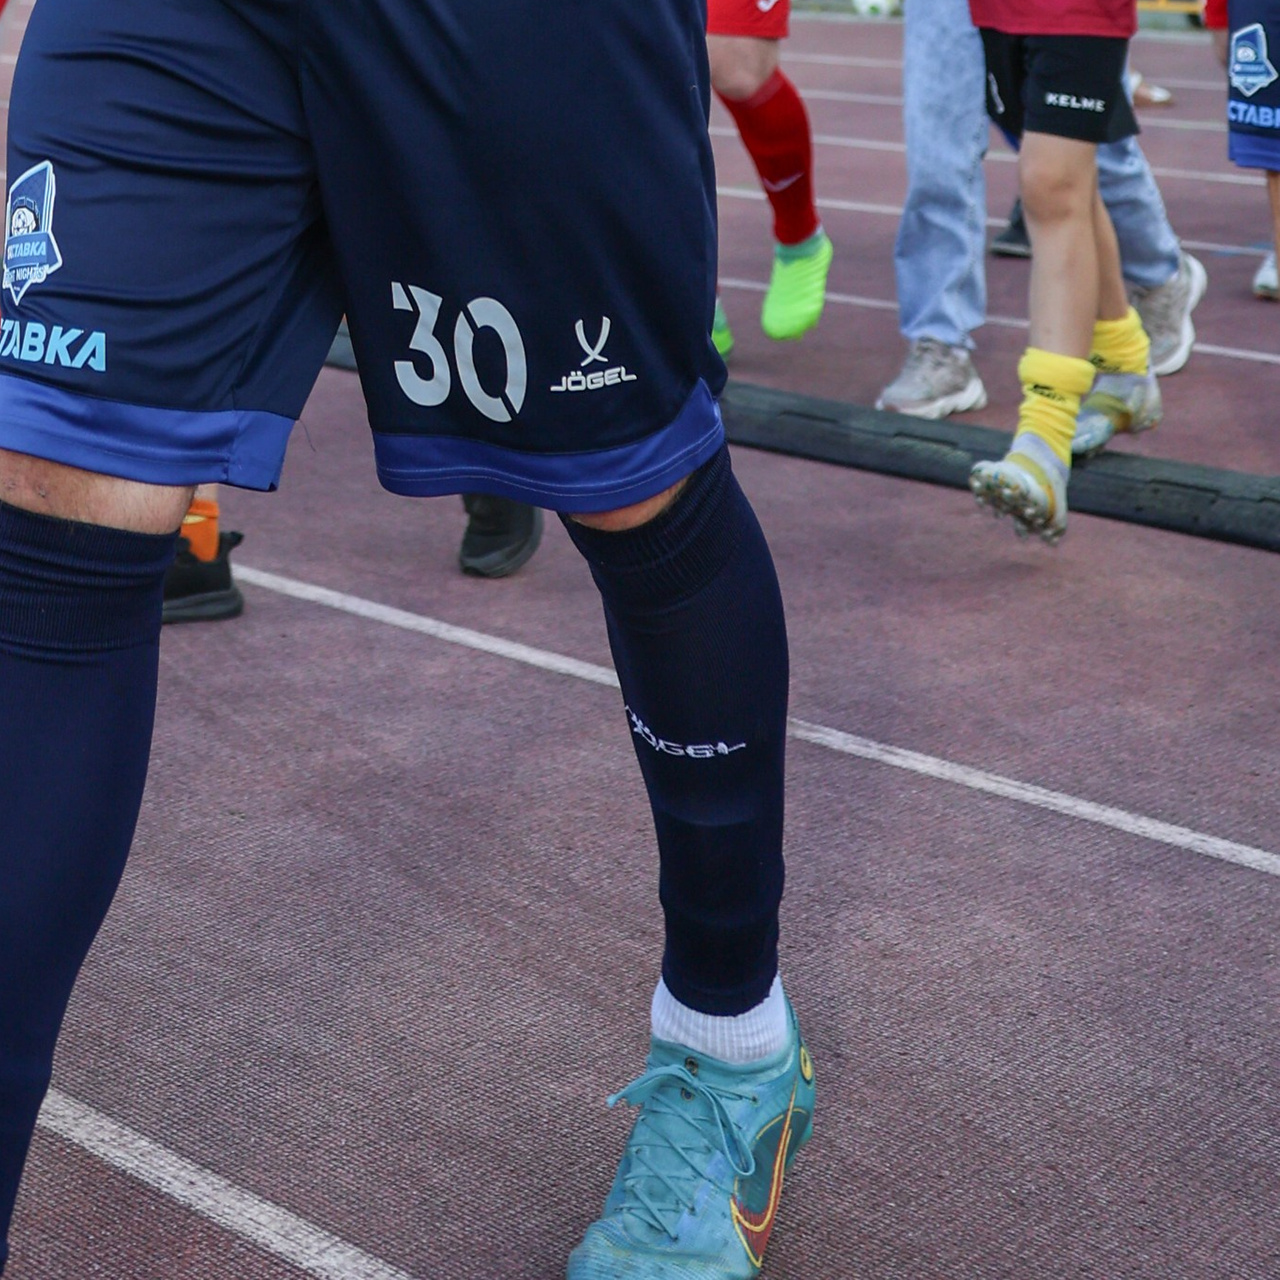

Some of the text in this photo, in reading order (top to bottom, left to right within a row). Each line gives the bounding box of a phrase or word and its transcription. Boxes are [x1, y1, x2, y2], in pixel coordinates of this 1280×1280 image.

[1045, 91, 1106, 113] KELME
[1228, 100, 1280, 129] СТАВ
[391, 281, 527, 423] 30
[550, 366, 637, 391] JÖGEL
